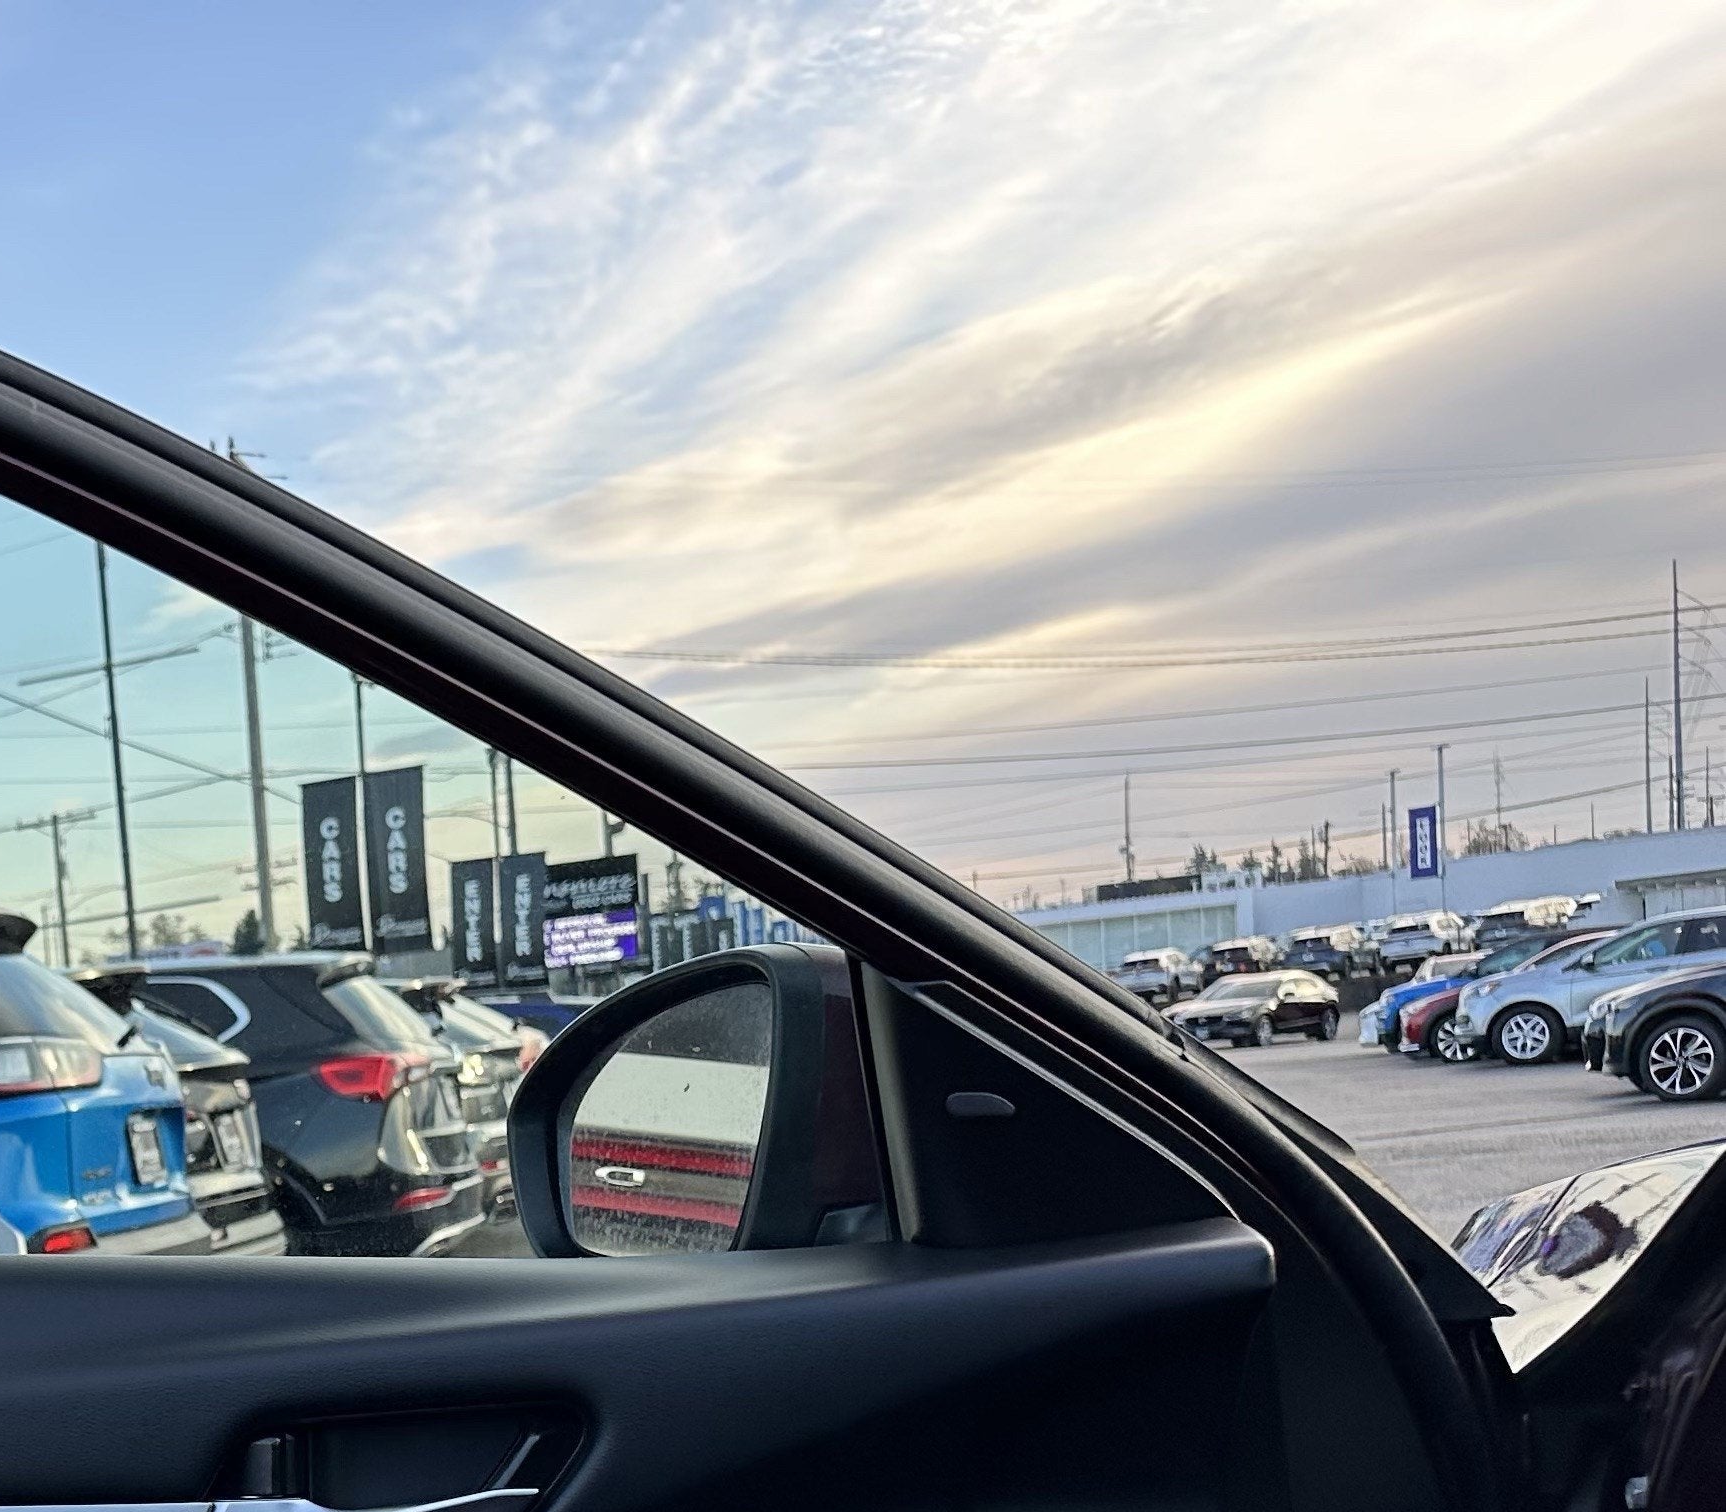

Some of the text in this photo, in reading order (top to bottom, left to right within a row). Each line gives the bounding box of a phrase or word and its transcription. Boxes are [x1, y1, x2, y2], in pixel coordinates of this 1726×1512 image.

[320, 816, 343, 902] CARS
[385, 806, 409, 894] CARS
[464, 879, 483, 962] ENTER
[515, 873, 532, 957] ENTER
